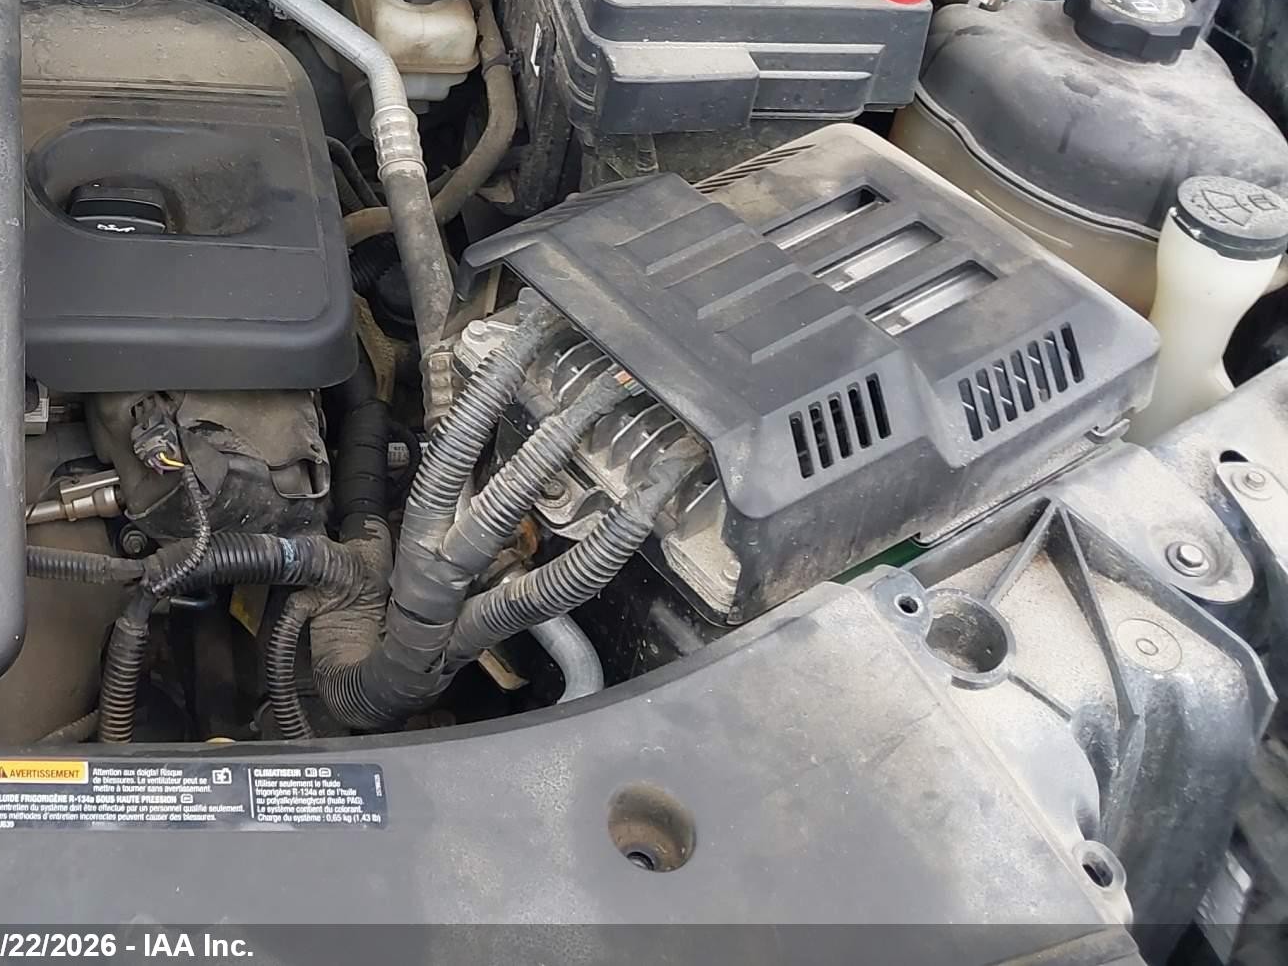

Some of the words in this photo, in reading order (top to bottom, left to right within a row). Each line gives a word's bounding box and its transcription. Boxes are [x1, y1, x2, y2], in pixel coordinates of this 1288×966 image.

[10, 769, 80, 778] AVERTISSEMENT
[92, 768, 122, 776] Attention
[123, 768, 136, 776] aux
[160, 768, 183, 777] Risque
[254, 769, 301, 777] CLIMATISEUR
[255, 780, 278, 788] Utiliser
[280, 780, 313, 788] seulement
[314, 780, 321, 788] le
[322, 780, 341, 788] fluide
[68, 794, 94, 803] R-134a
[96, 795, 116, 803] SOUS
[116, 795, 140, 803] HAUTE
[141, 795, 177, 804] PRESSION
[40, 804, 68, 813] système
[70, 804, 82, 812] doit
[98, 804, 125, 812] effectué
[150, 805, 182, 813] personnel
[183, 805, 208, 813] qualifié
[267, 806, 294, 814] système
[8, 812, 41, 820] méthodes
[80, 813, 116, 821] incorrectes
[118, 814, 144, 822] peuvent
[258, 814, 282, 822] Charge
[283, 814, 292, 822] du
[294, 814, 322, 823] système
[343, 814, 352, 823] kg
